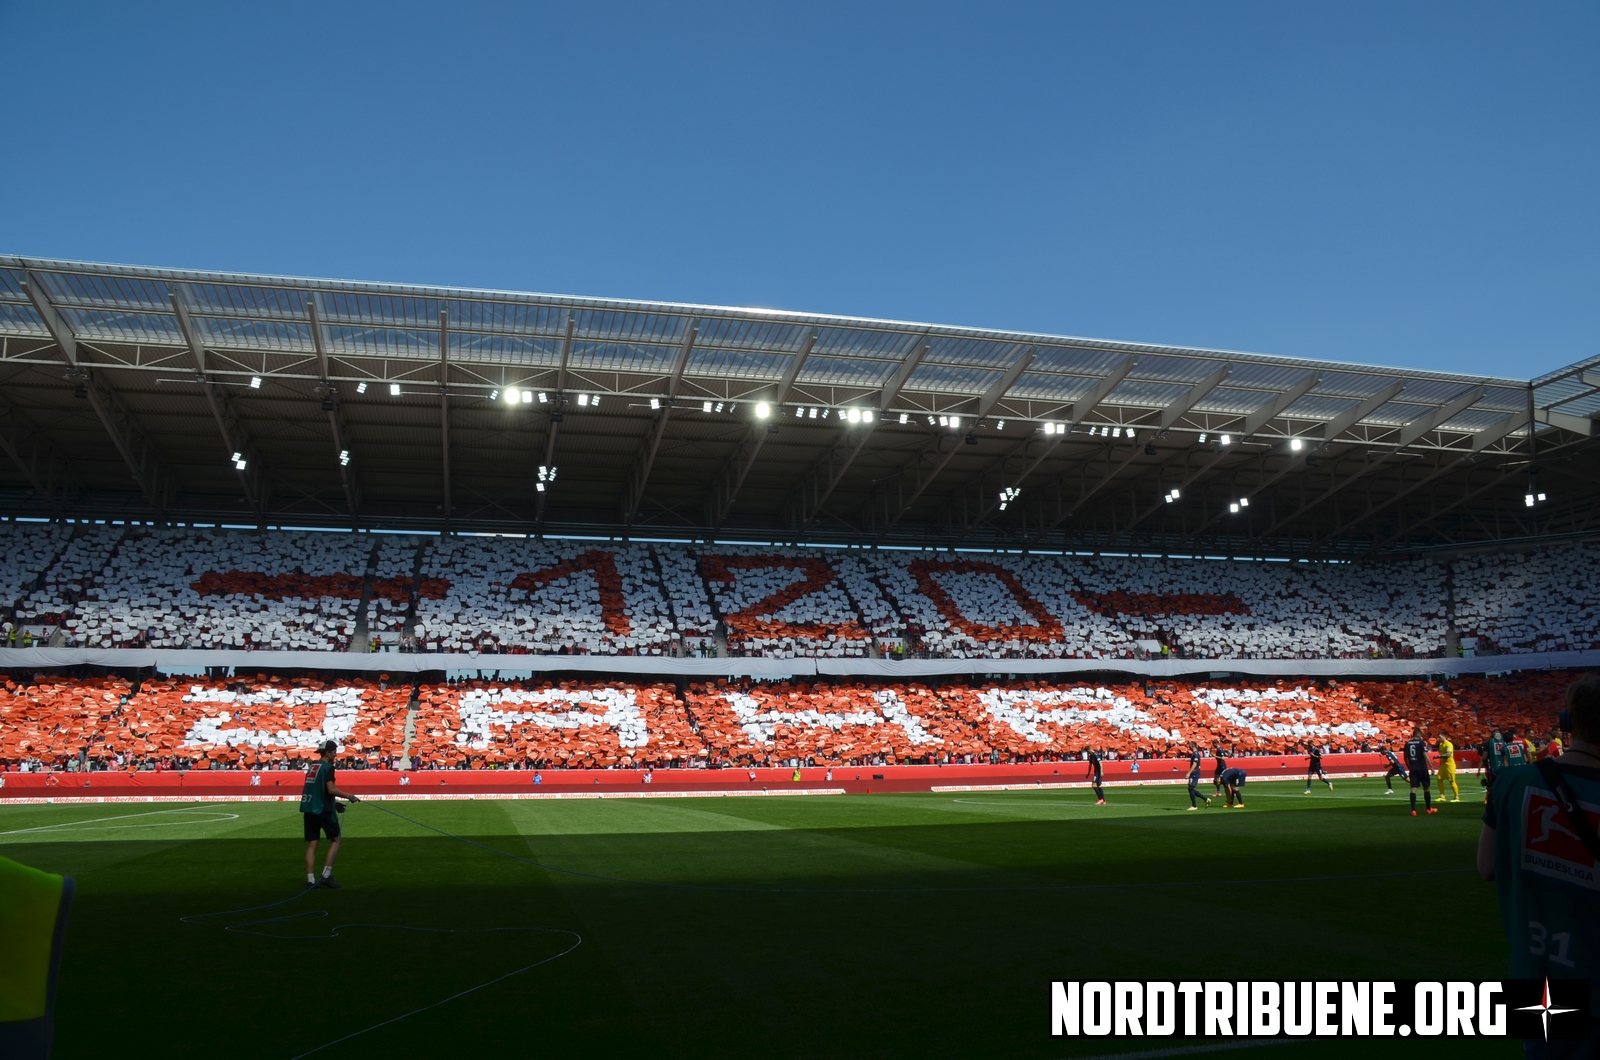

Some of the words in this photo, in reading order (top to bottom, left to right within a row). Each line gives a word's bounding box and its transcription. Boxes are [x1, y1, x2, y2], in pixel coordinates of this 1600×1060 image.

[302, 793, 313, 803] 37
[1524, 853, 1594, 882] BUNDESLIGA
[1527, 920, 1575, 969] 31
